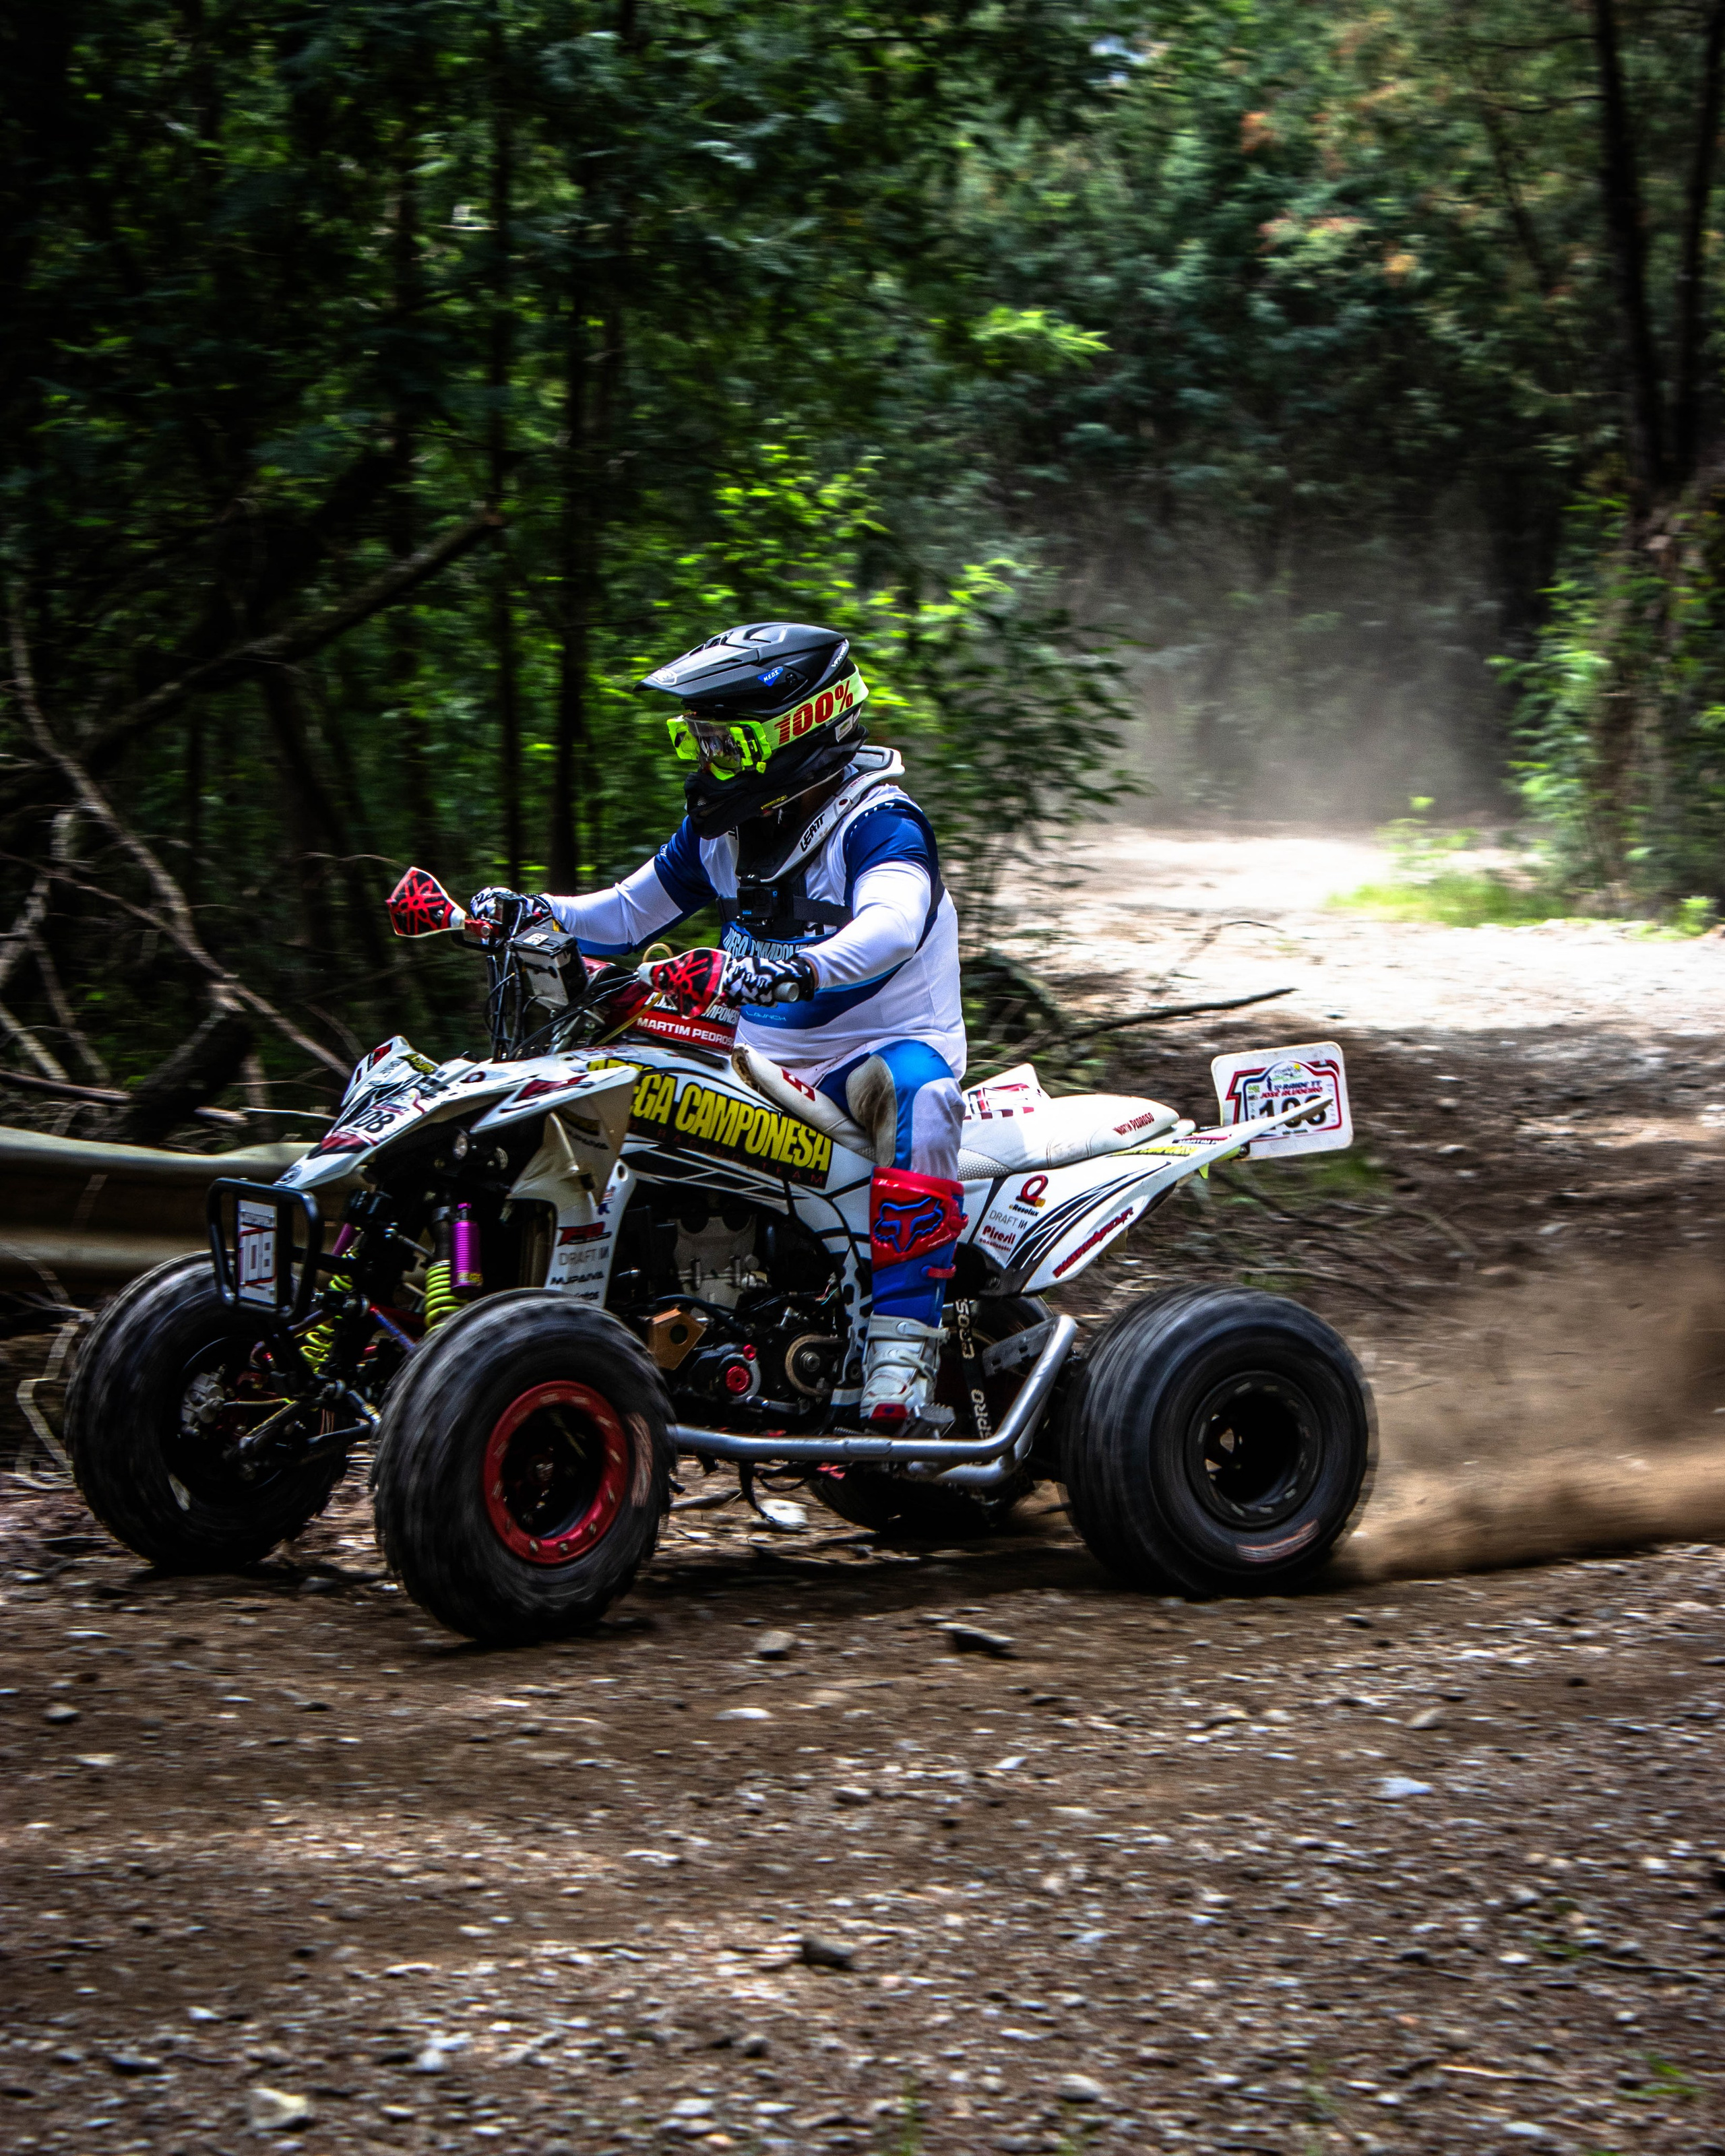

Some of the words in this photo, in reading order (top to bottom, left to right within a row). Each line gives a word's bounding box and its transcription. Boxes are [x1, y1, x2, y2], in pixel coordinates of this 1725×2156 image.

[774, 680, 854, 745] 100%
[800, 813, 825, 852] LEATT
[637, 1017, 690, 1036] MARTIM
[746, 1011, 786, 1021] LAUNCH
[675, 1084, 832, 1171] CAMPONESA
[989, 1210, 1019, 1226] DRAFT
